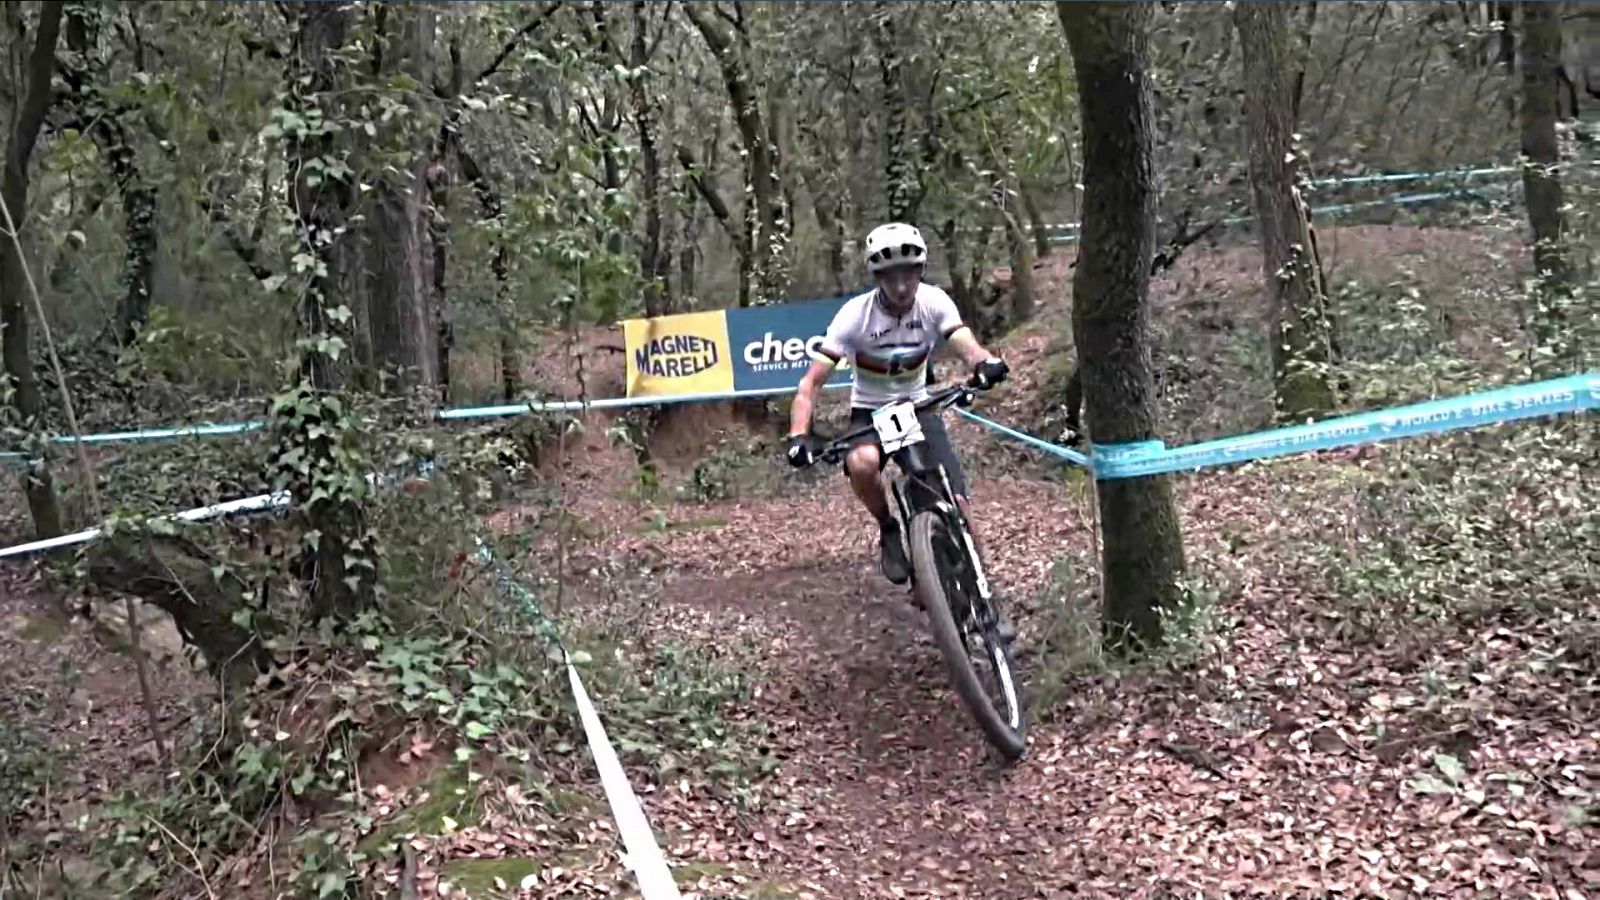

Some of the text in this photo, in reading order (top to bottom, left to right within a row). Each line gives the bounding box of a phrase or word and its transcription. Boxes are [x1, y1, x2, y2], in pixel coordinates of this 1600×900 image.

[635, 334, 718, 362] MAGNETI
[743, 331, 824, 365] chec
[637, 354, 718, 377] MARELLI
[753, 361, 788, 372] SERVICE
[1512, 390, 1575, 410] SERIES
[889, 413, 903, 433] 1
